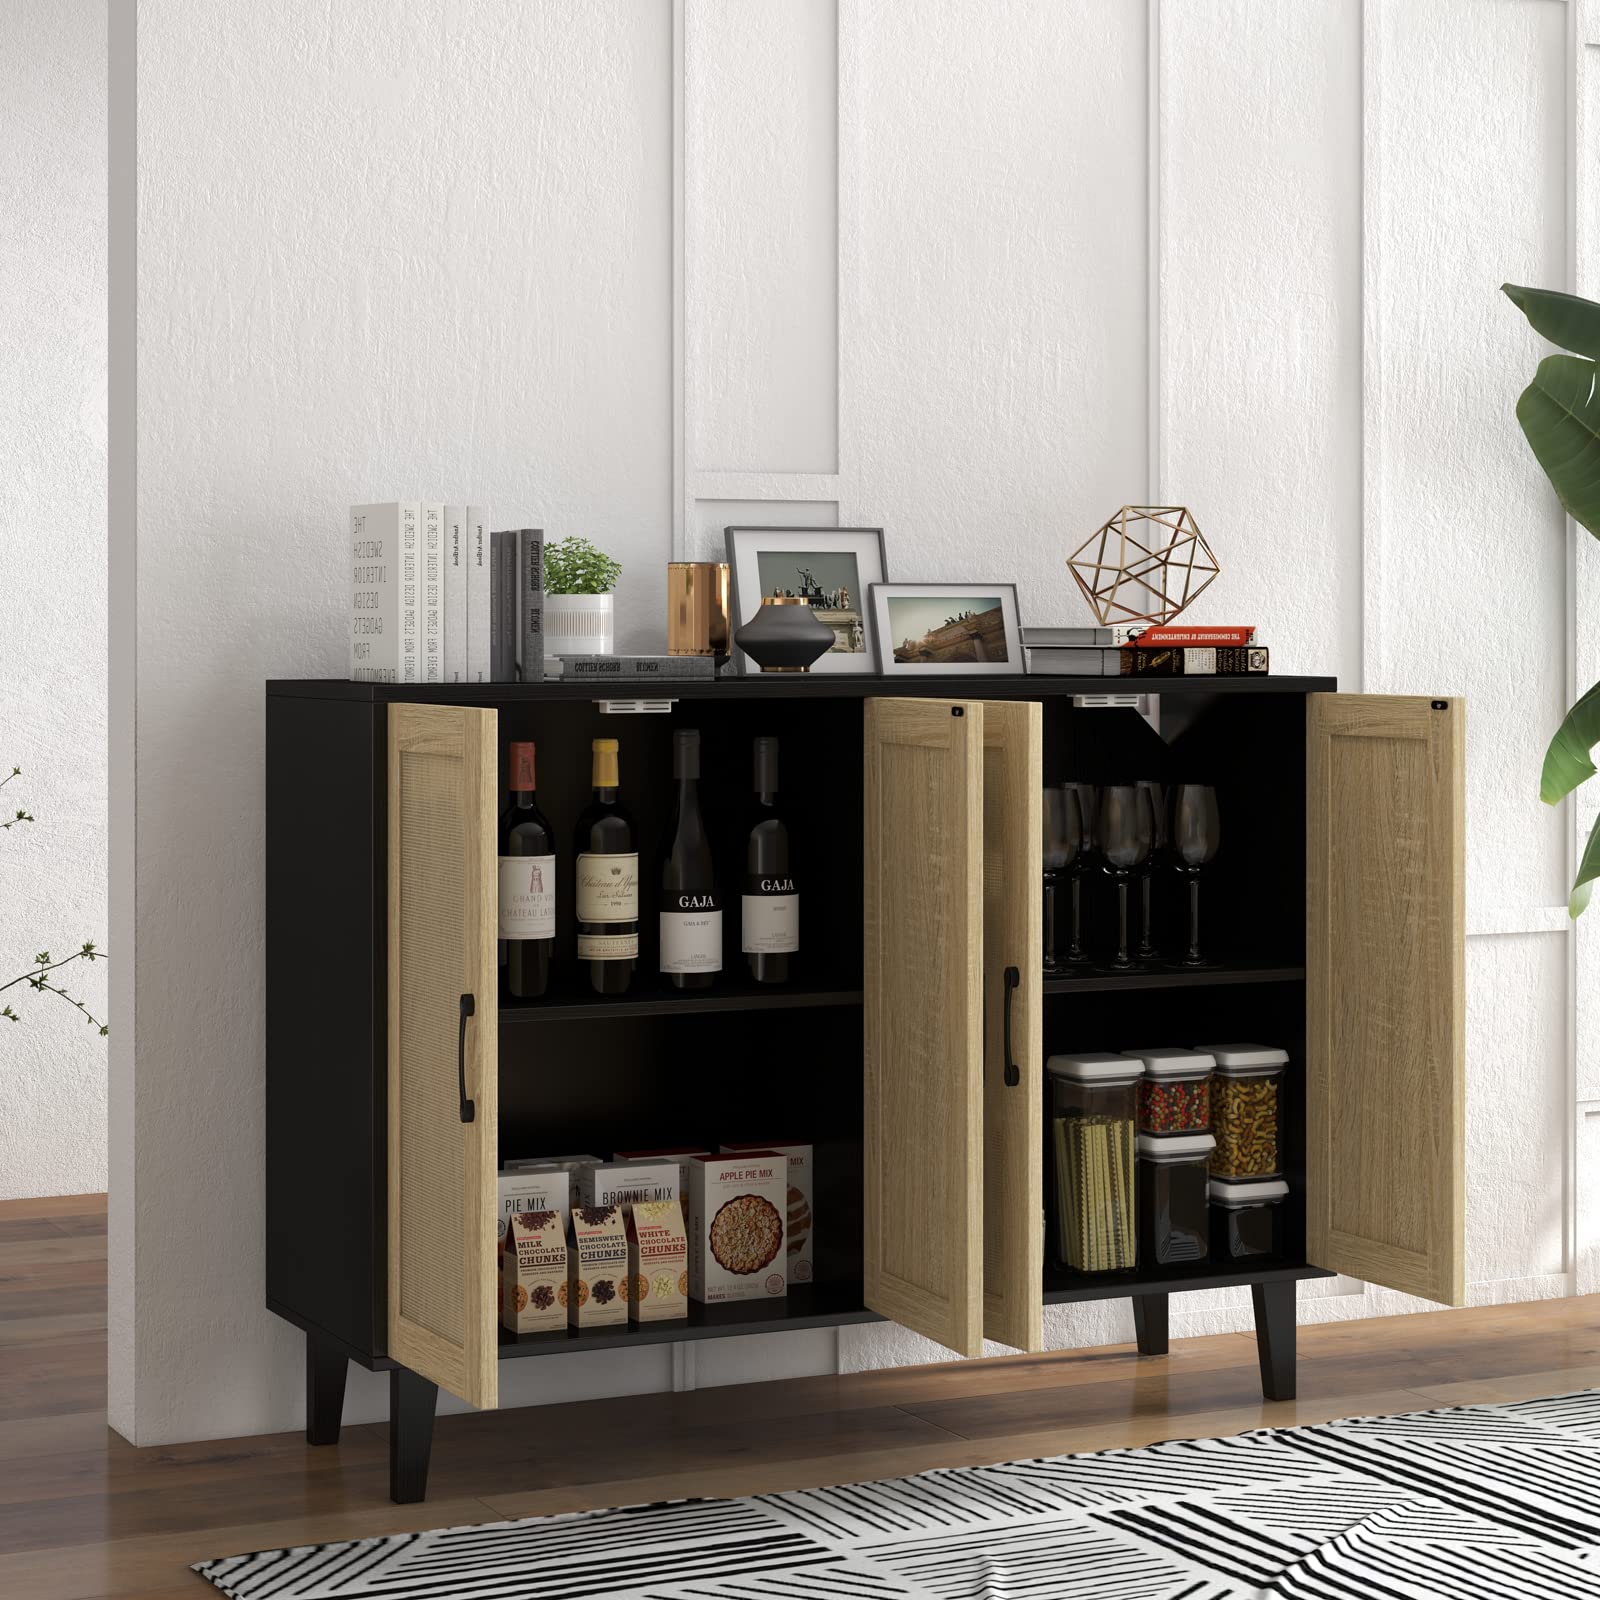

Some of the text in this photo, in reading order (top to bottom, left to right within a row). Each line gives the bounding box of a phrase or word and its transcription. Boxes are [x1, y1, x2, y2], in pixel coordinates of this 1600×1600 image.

[761, 880, 795, 891] GAJA
[678, 896, 716, 908] GAJA
[720, 1169, 773, 1181] APPLE PIE MIX
[603, 1188, 648, 1205] BROWNIE
[654, 1187, 672, 1200] MIX
[505, 1196, 546, 1212] PIE MIX
[578, 1234, 624, 1244] SEMISWEET
[639, 1230, 670, 1238] WHITE
[518, 1240, 542, 1248] MILK
[640, 1236, 685, 1245] CHOCOLATE
[580, 1242, 626, 1250] CHOCOLATE
[641, 1244, 686, 1254] CHUNKS
[519, 1247, 565, 1256] CHOCOLATE
[581, 1249, 626, 1260] CHUNKS
[520, 1254, 566, 1265] CHUNKS
